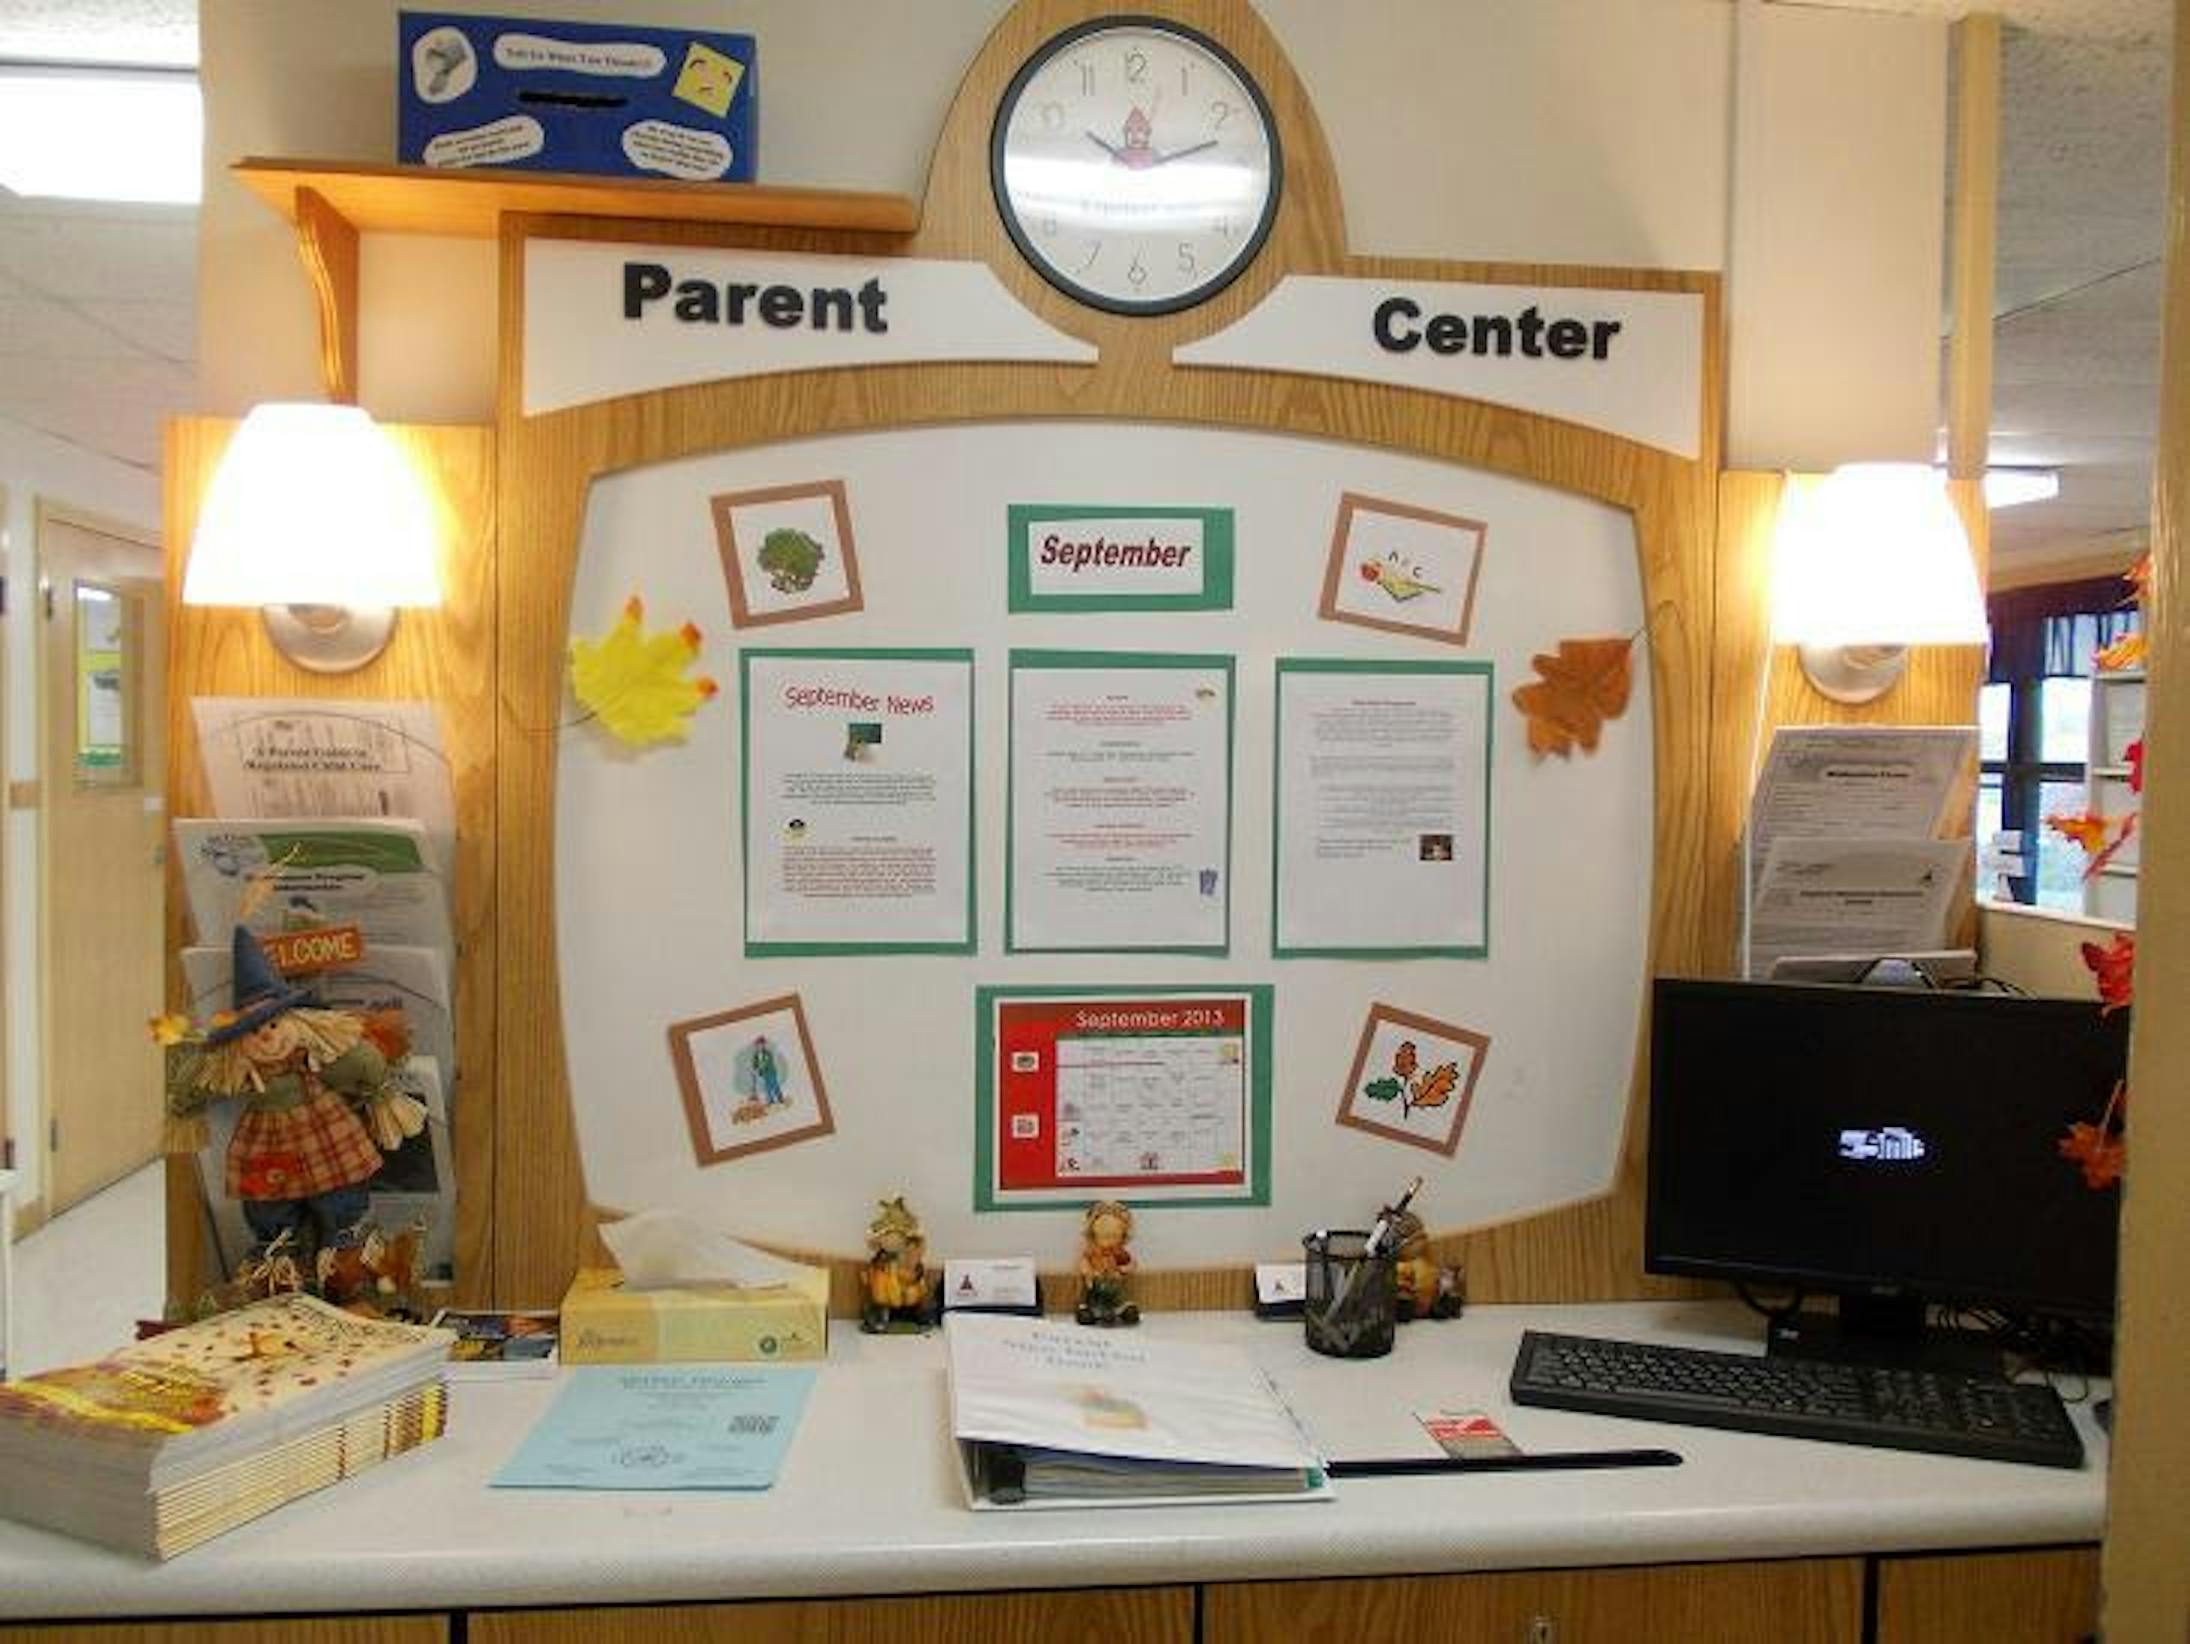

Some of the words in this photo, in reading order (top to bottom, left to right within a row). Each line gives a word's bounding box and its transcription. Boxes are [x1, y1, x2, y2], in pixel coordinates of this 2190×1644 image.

[1081, 61, 1096, 96] 11
[1124, 51, 1147, 83] 12
[1211, 101, 1228, 130] 2
[623, 262, 888, 333] Parent
[1373, 297, 1621, 360] Center
[1041, 535, 1191, 572] September
[785, 686, 880, 712] September
[886, 695, 934, 714] News
[1076, 1009, 1178, 1030] September
[1182, 1008, 1226, 1026] 2013
